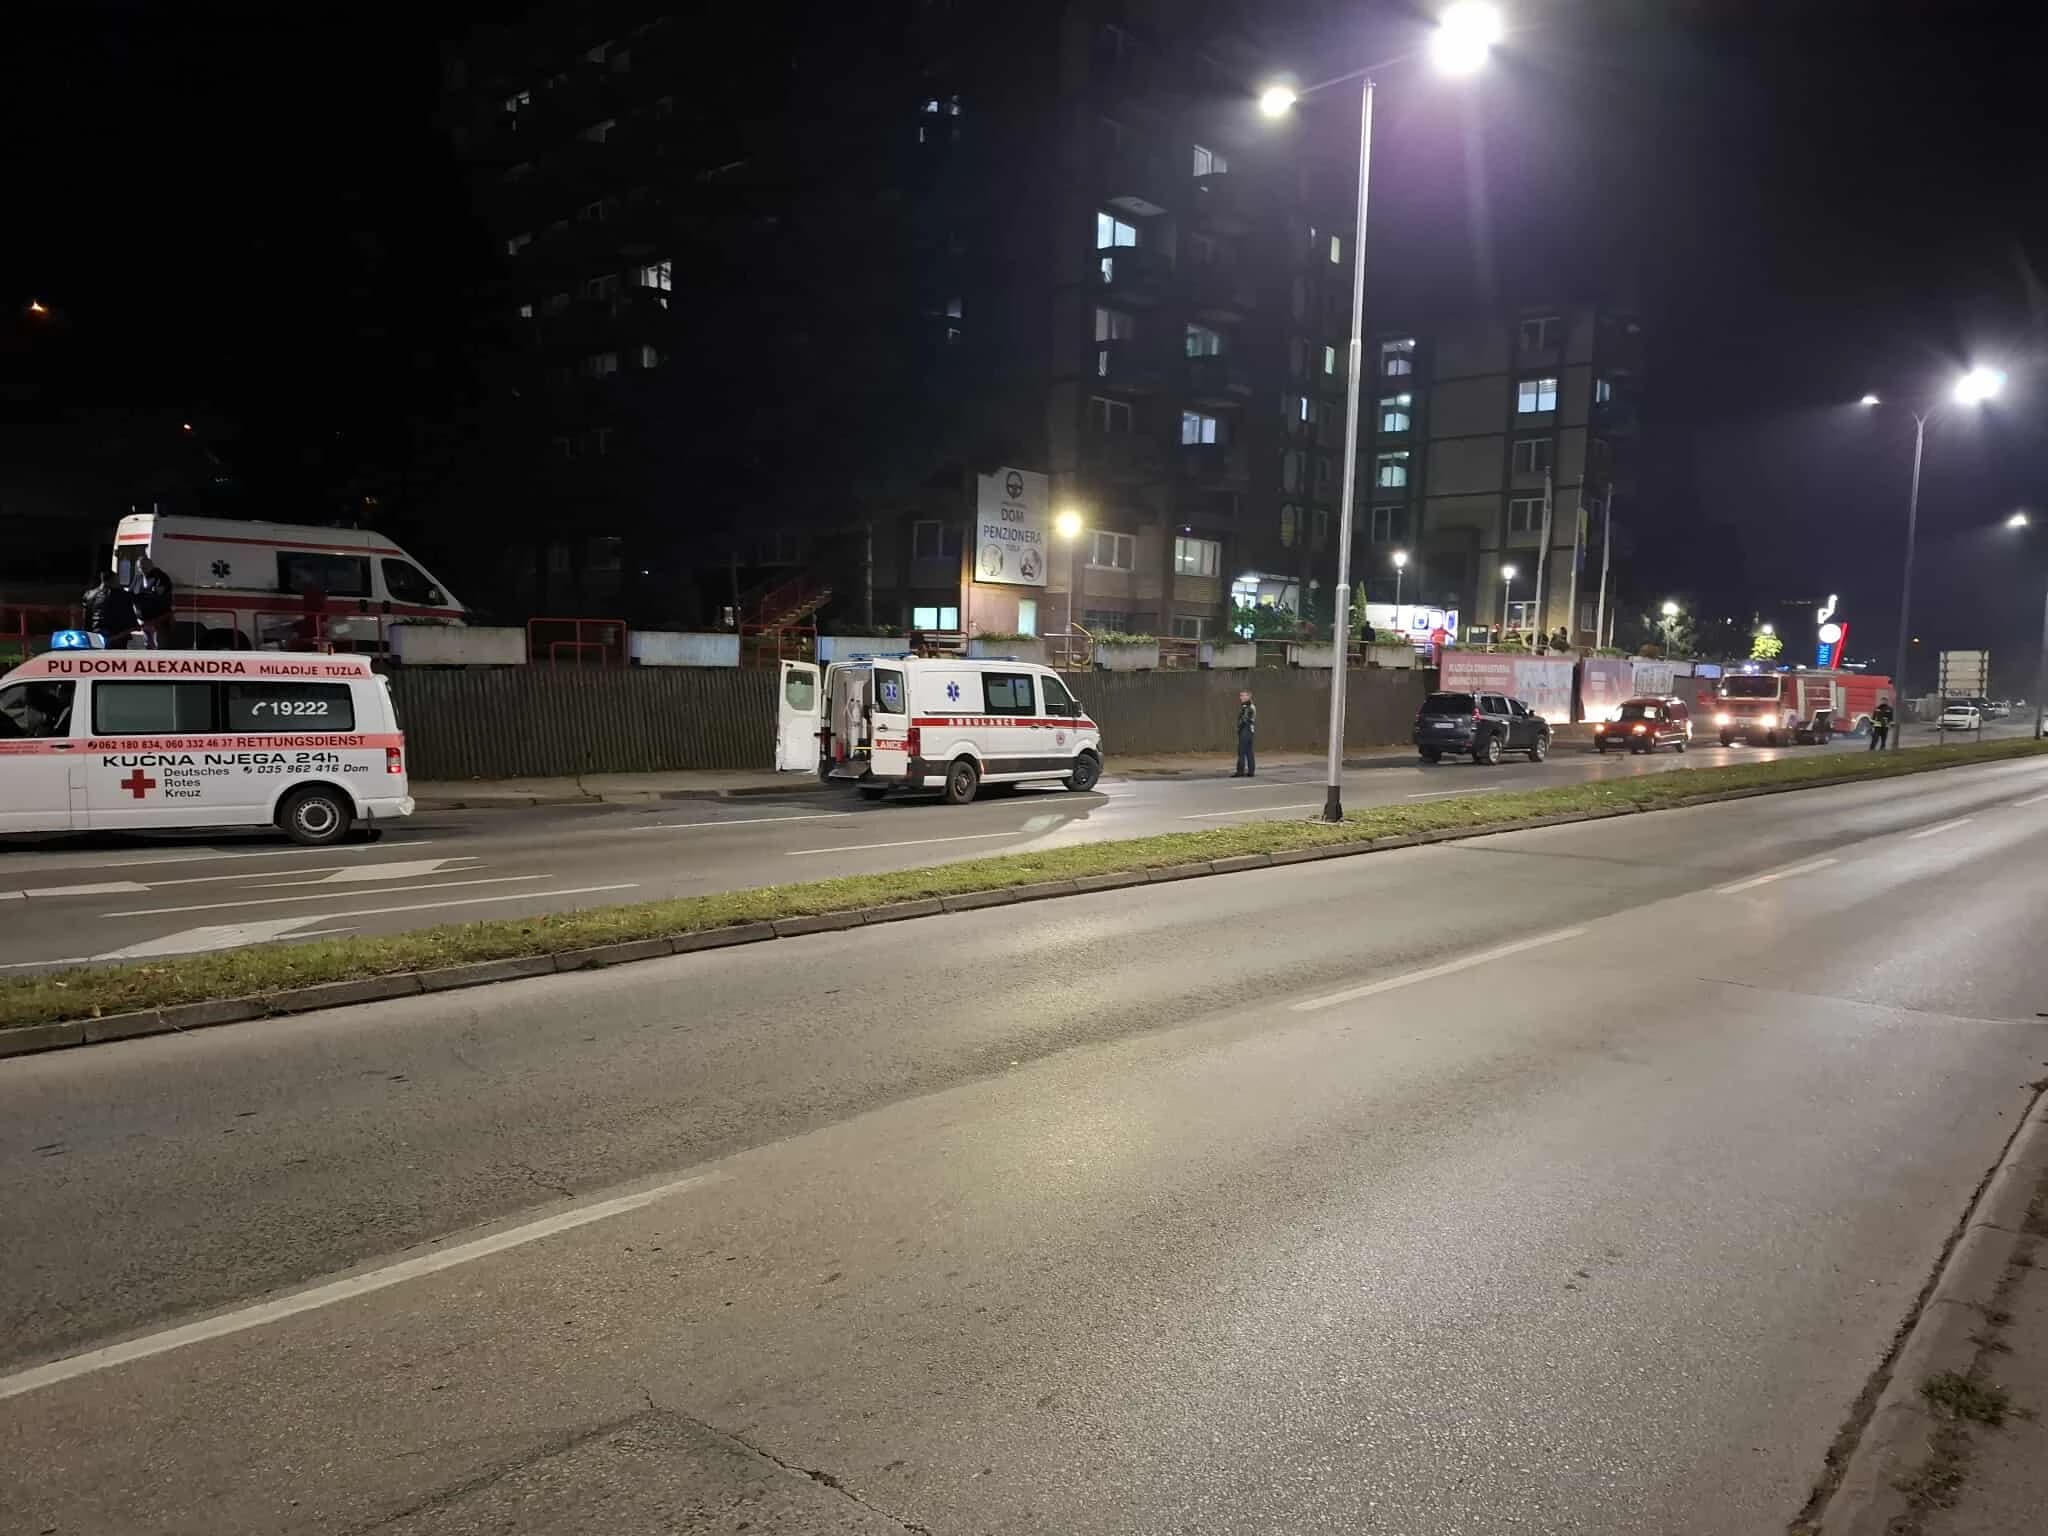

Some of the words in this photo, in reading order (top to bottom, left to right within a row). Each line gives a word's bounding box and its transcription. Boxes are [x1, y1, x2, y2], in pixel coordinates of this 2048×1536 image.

[1001, 508, 1024, 523] DOM
[983, 525, 1042, 544] PENZIONERA
[48, 660, 73, 673] PU
[79, 660, 127, 673] DOM
[134, 660, 246, 674] ALEXANDRA
[259, 665, 318, 676] MILADIJE
[325, 666, 362, 676] TUZLA
[270, 701, 328, 716] 19222
[948, 717, 1017, 727] AMBULANCE
[121, 740, 139, 750] 180
[166, 739, 184, 749] 060
[186, 739, 205, 749] 332
[236, 735, 366, 748] RETTUNGSDIENST
[205, 753, 287, 765] NJEGA
[295, 752, 339, 764] 24h
[164, 767, 230, 778] Deutsches
[257, 765, 282, 775] 035
[286, 764, 312, 774] 962
[343, 763, 369, 773] Dom
[164, 778, 201, 788] Rotes
[164, 788, 201, 798] Kreuz
